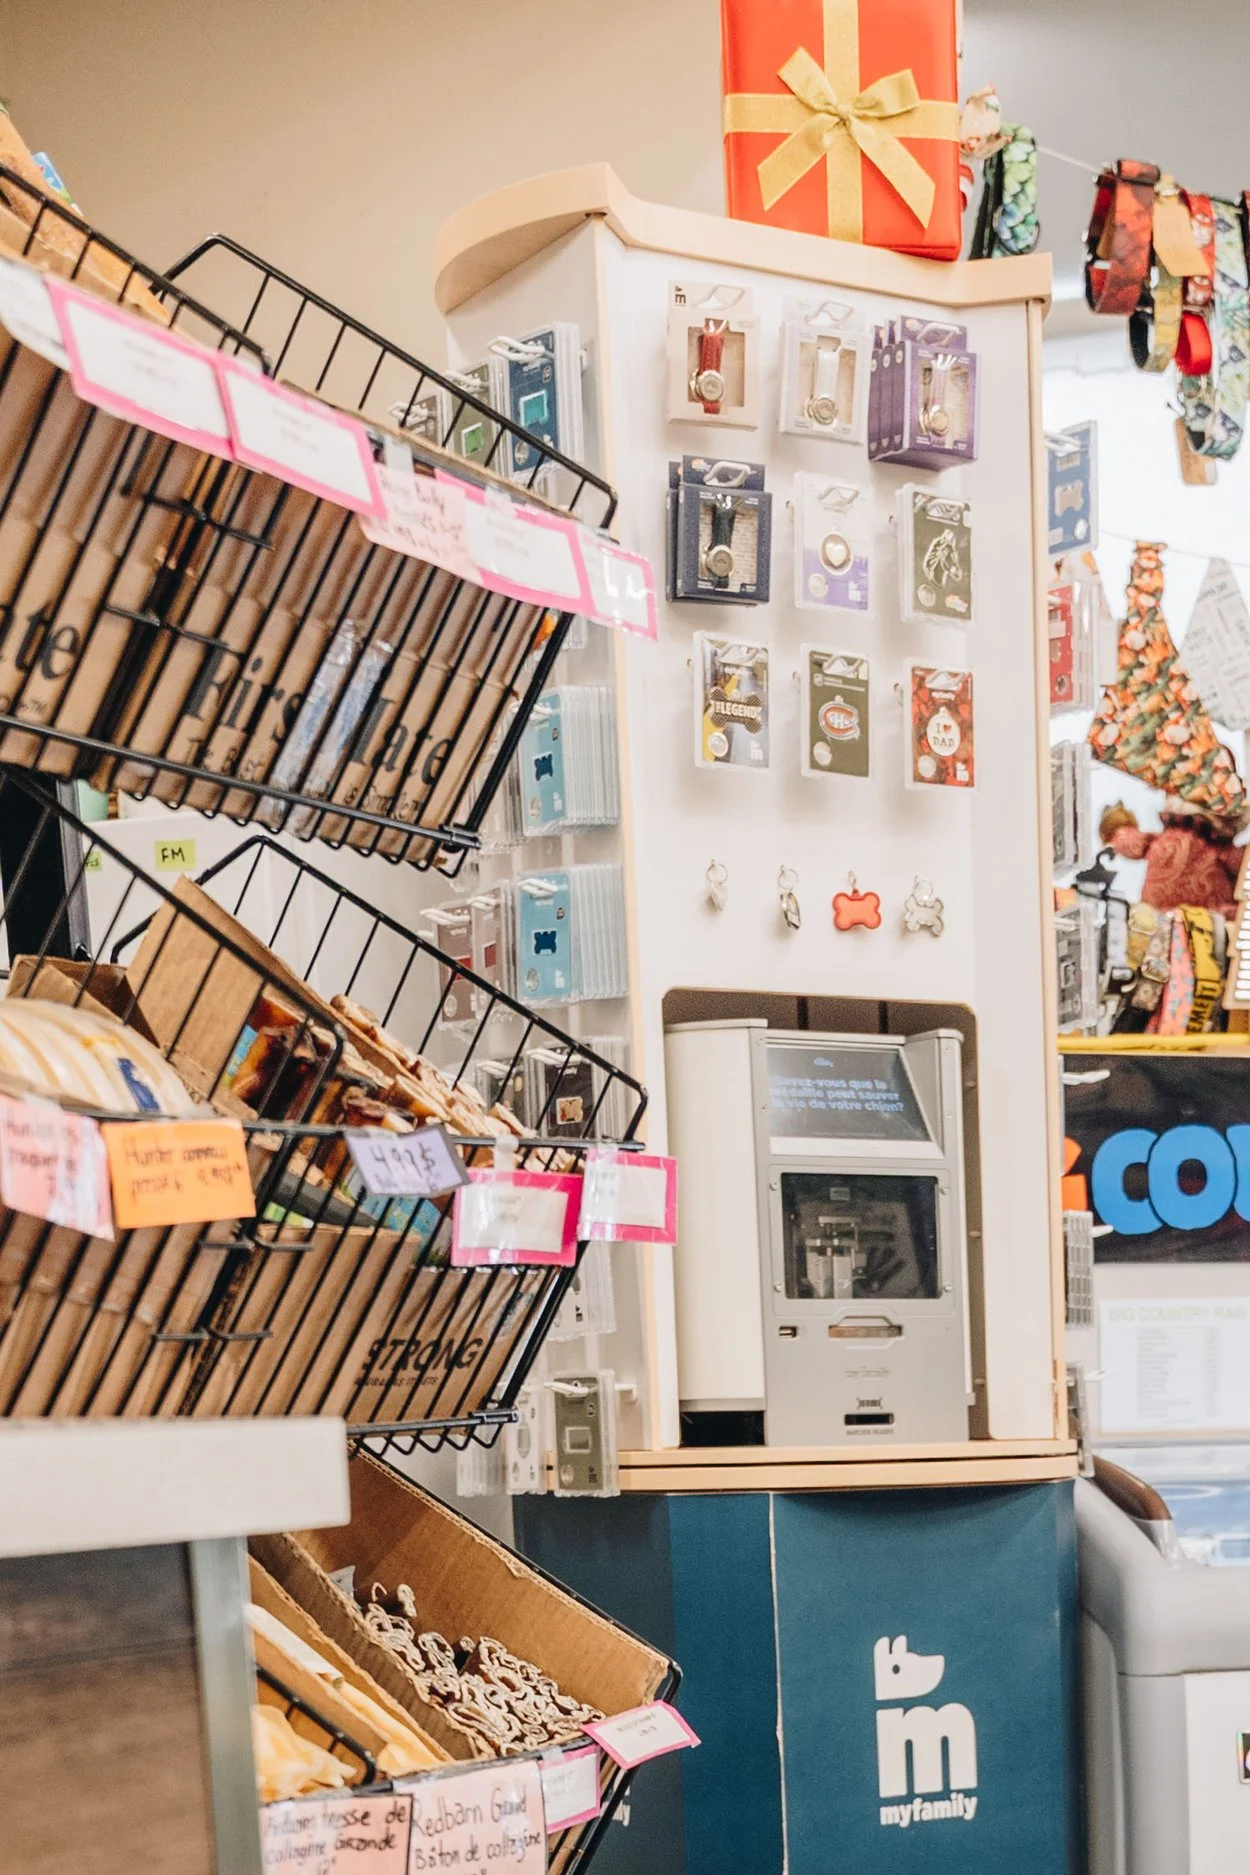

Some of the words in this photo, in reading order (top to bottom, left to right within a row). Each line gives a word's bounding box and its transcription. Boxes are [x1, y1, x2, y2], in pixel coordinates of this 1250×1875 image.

[933, 736, 955, 748] DAD
[160, 846, 186, 863] FM
[848, 1079, 873, 1091] que
[384, 1798, 408, 1825] de
[411, 1796, 484, 1838] Redbarn
[879, 1791, 979, 1828] myfamily
[464, 1833, 482, 1862] de
